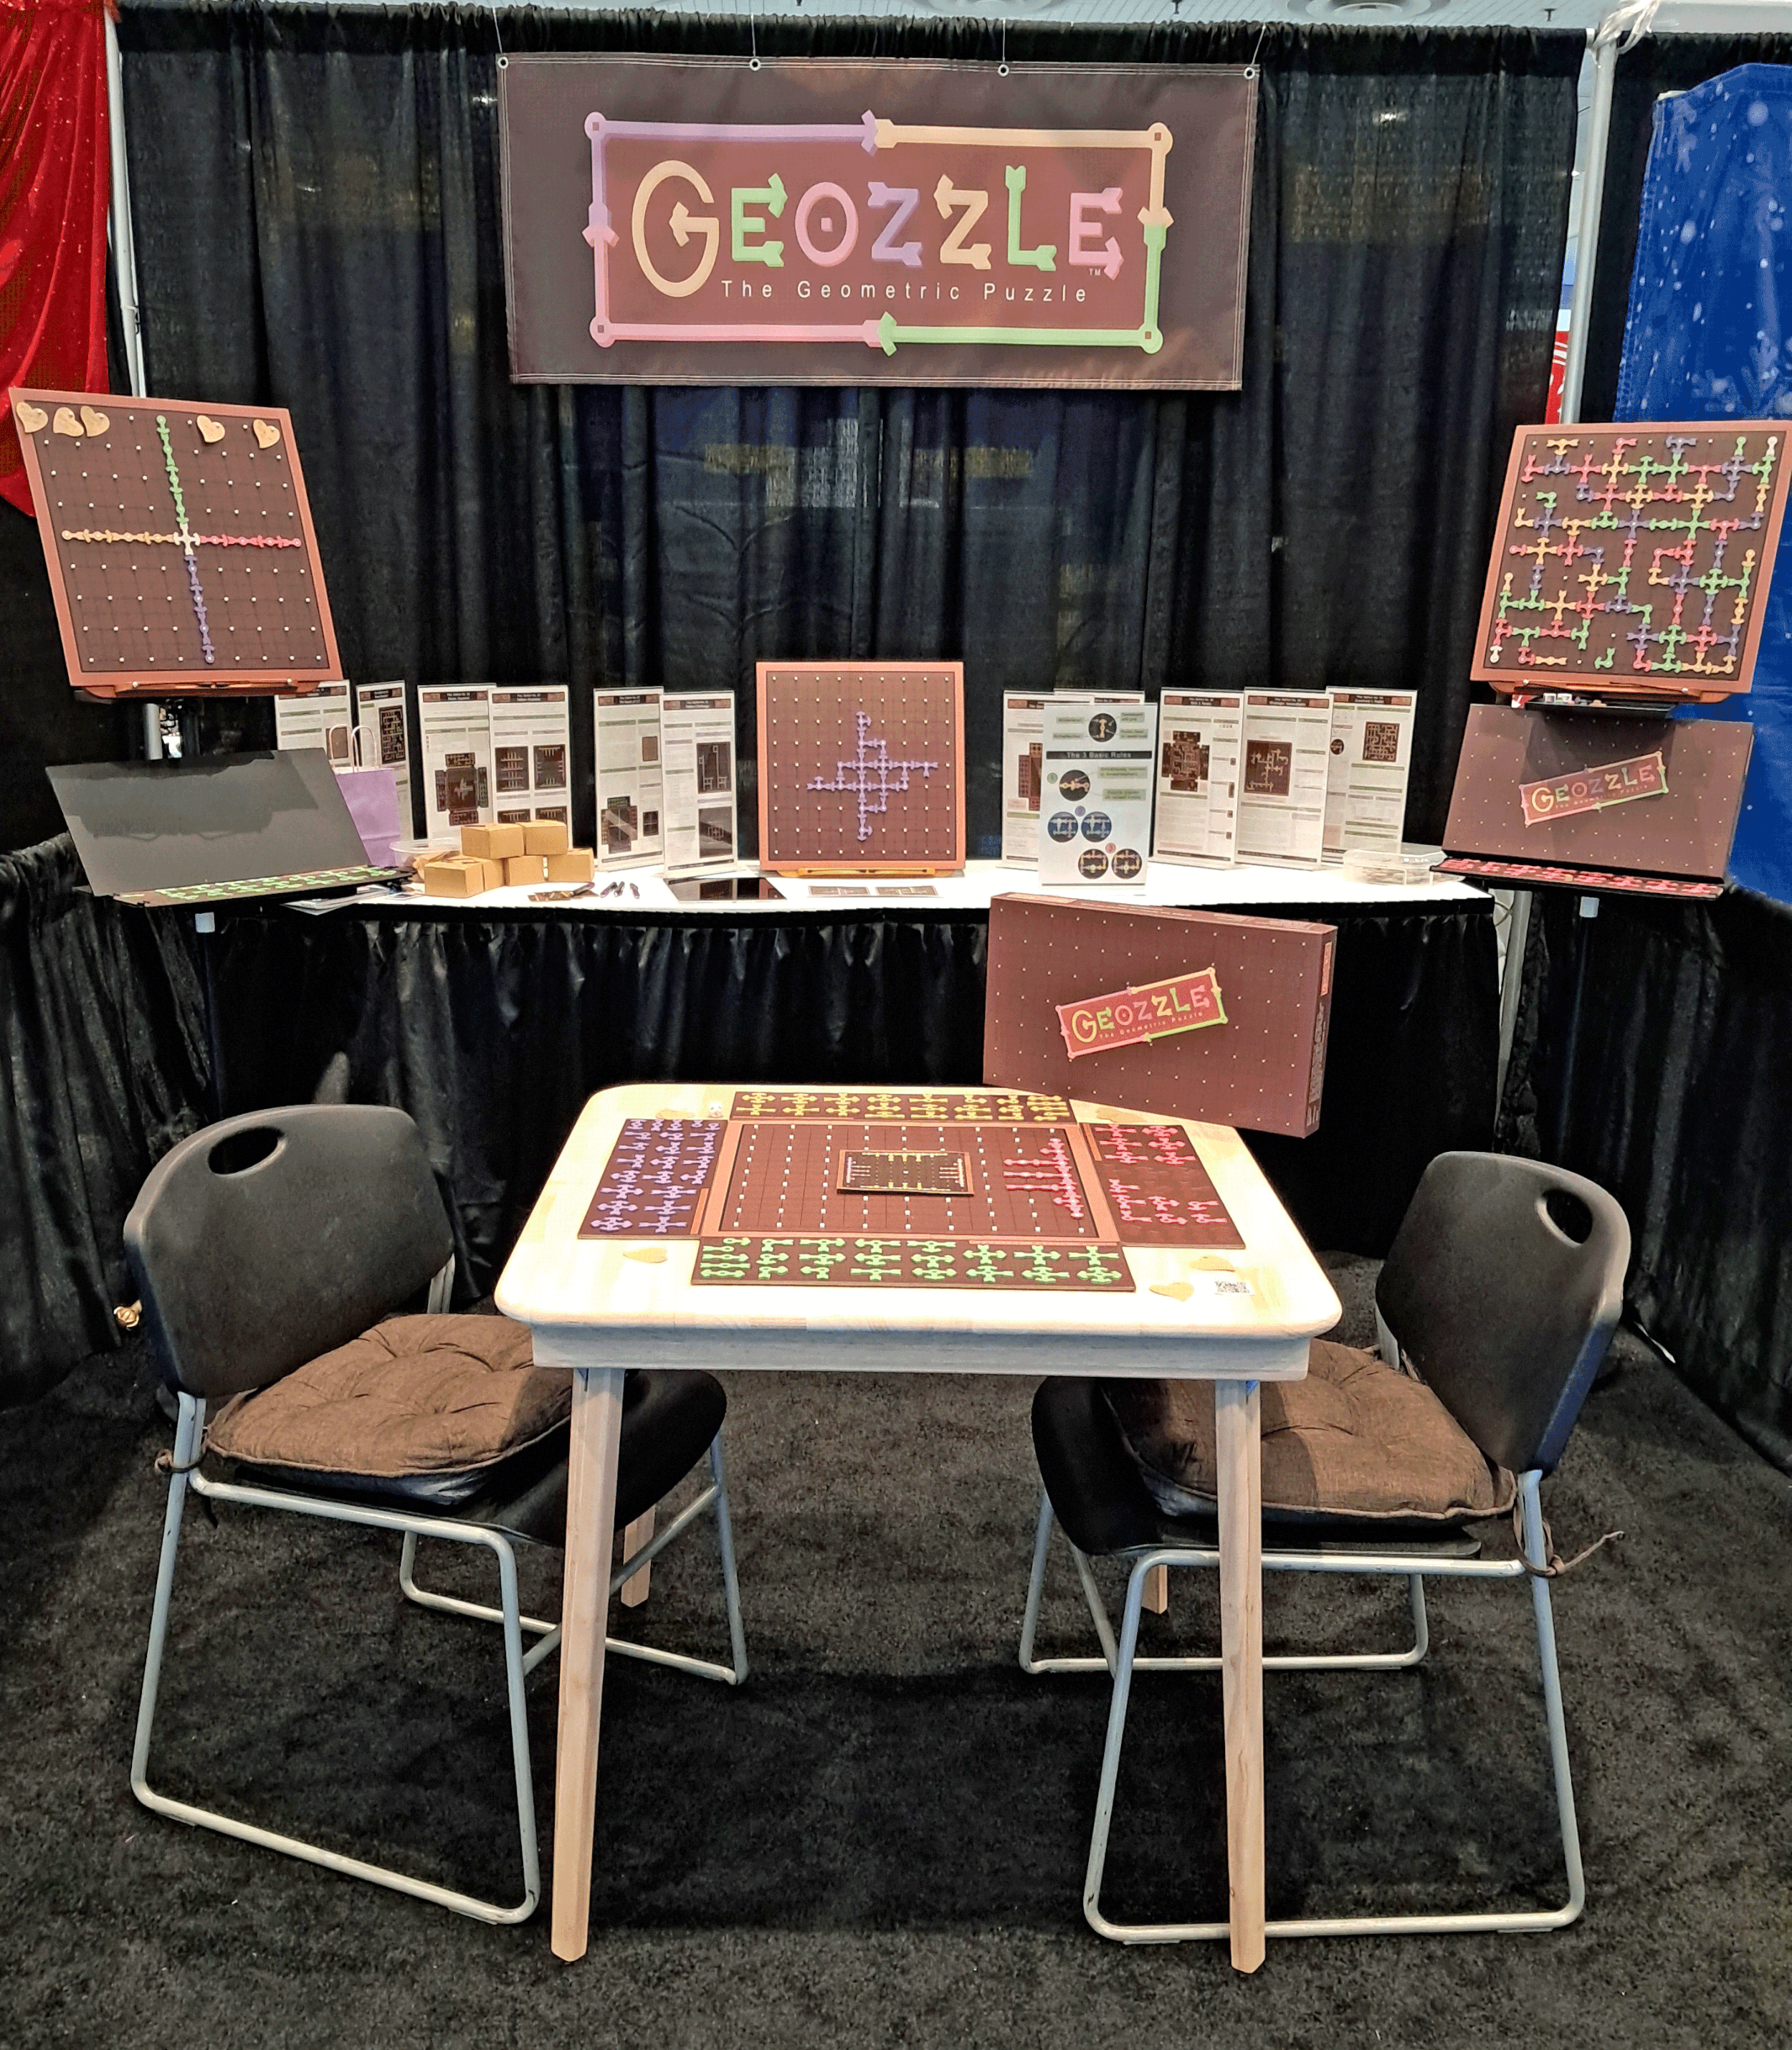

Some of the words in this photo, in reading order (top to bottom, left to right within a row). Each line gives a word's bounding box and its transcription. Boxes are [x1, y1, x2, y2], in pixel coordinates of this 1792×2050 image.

[632, 160, 1124, 297] GEOZZLE
[721, 280, 773, 297] The
[797, 280, 960, 299] Geometric
[984, 282, 1087, 302] Puzzle
[1531, 764, 1655, 813] GEOZZLE
[1072, 984, 1211, 1043] GEOZZLE
